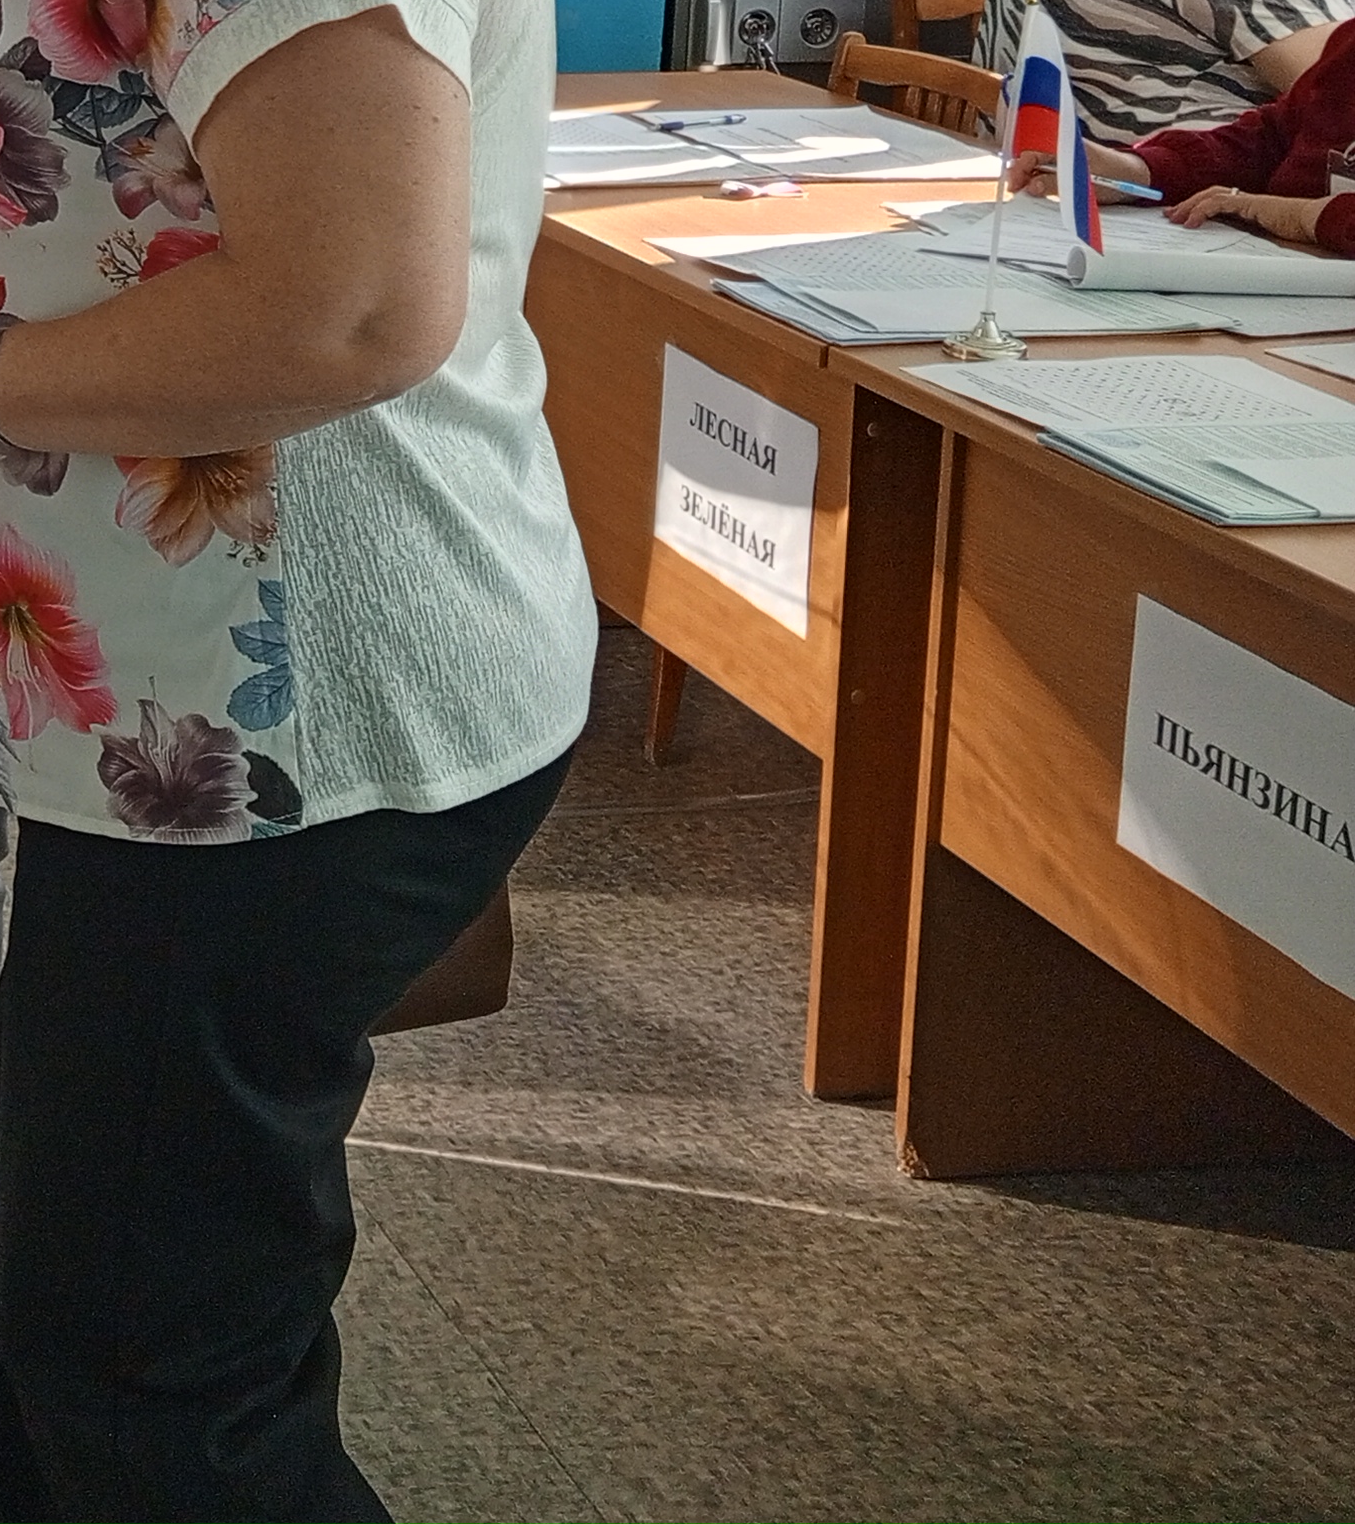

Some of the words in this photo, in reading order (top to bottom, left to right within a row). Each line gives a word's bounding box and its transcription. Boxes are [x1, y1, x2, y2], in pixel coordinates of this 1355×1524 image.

[690, 402, 778, 476] ЛЕСНАЯ
[680, 484, 776, 570] ЗЕЛЁНАЯ
[1153, 712, 1355, 863] ПЬЯНЗИНА
